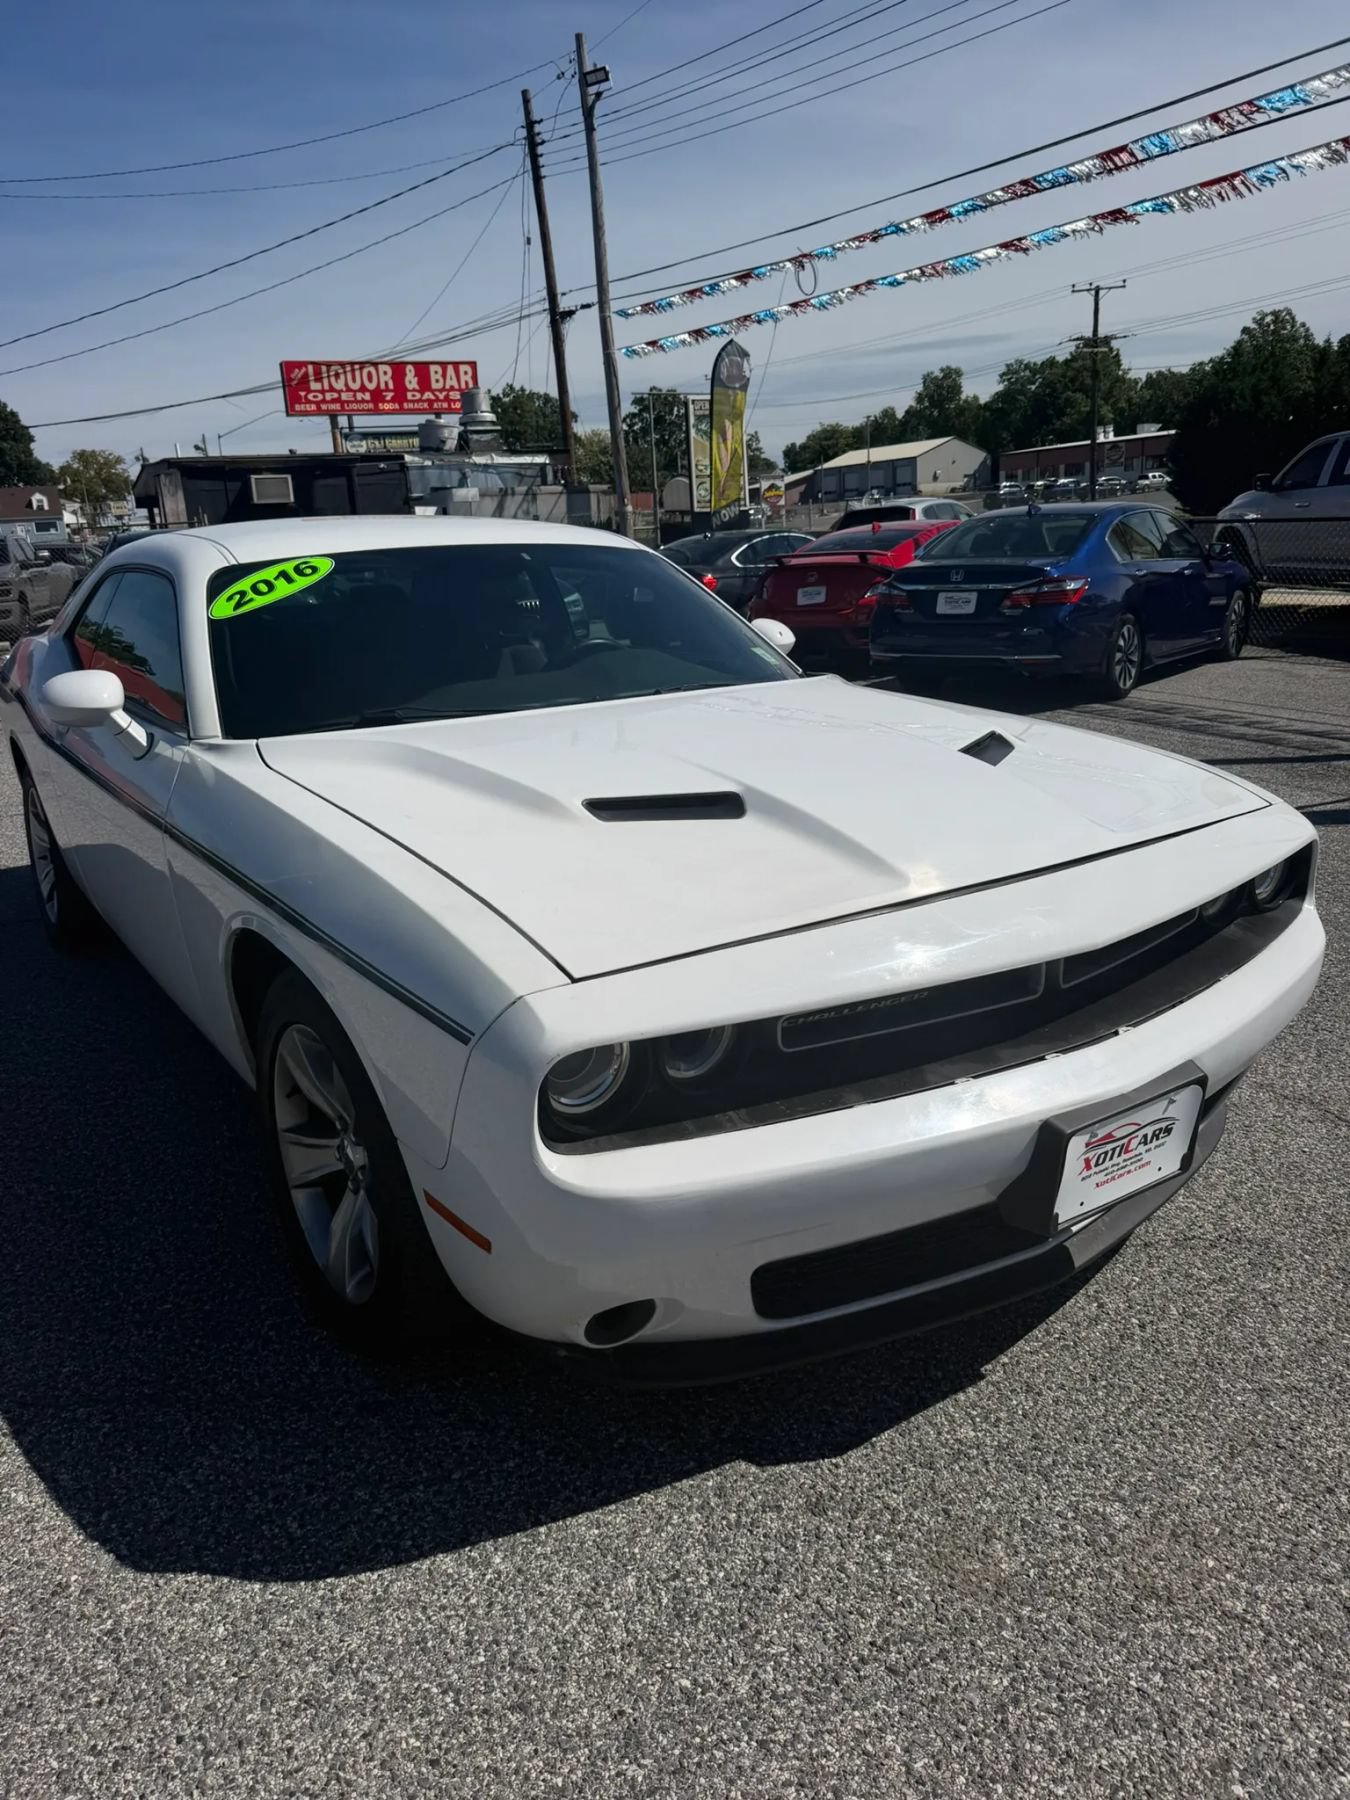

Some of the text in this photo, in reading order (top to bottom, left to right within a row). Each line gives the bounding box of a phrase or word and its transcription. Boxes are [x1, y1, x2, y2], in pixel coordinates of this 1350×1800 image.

[307, 364, 474, 391] LIQUOR & BAR
[294, 403, 317, 412] BEER
[320, 403, 342, 411] WINE
[344, 402, 374, 411] LIQUOR
[378, 402, 400, 410] SODA
[403, 402, 429, 410] SNACK
[307, 391, 462, 401] OPEN 7 DAYS
[712, 502, 739, 528] NOW
[226, 561, 319, 612] 2016
[783, 991, 928, 1028] CHALLENGER
